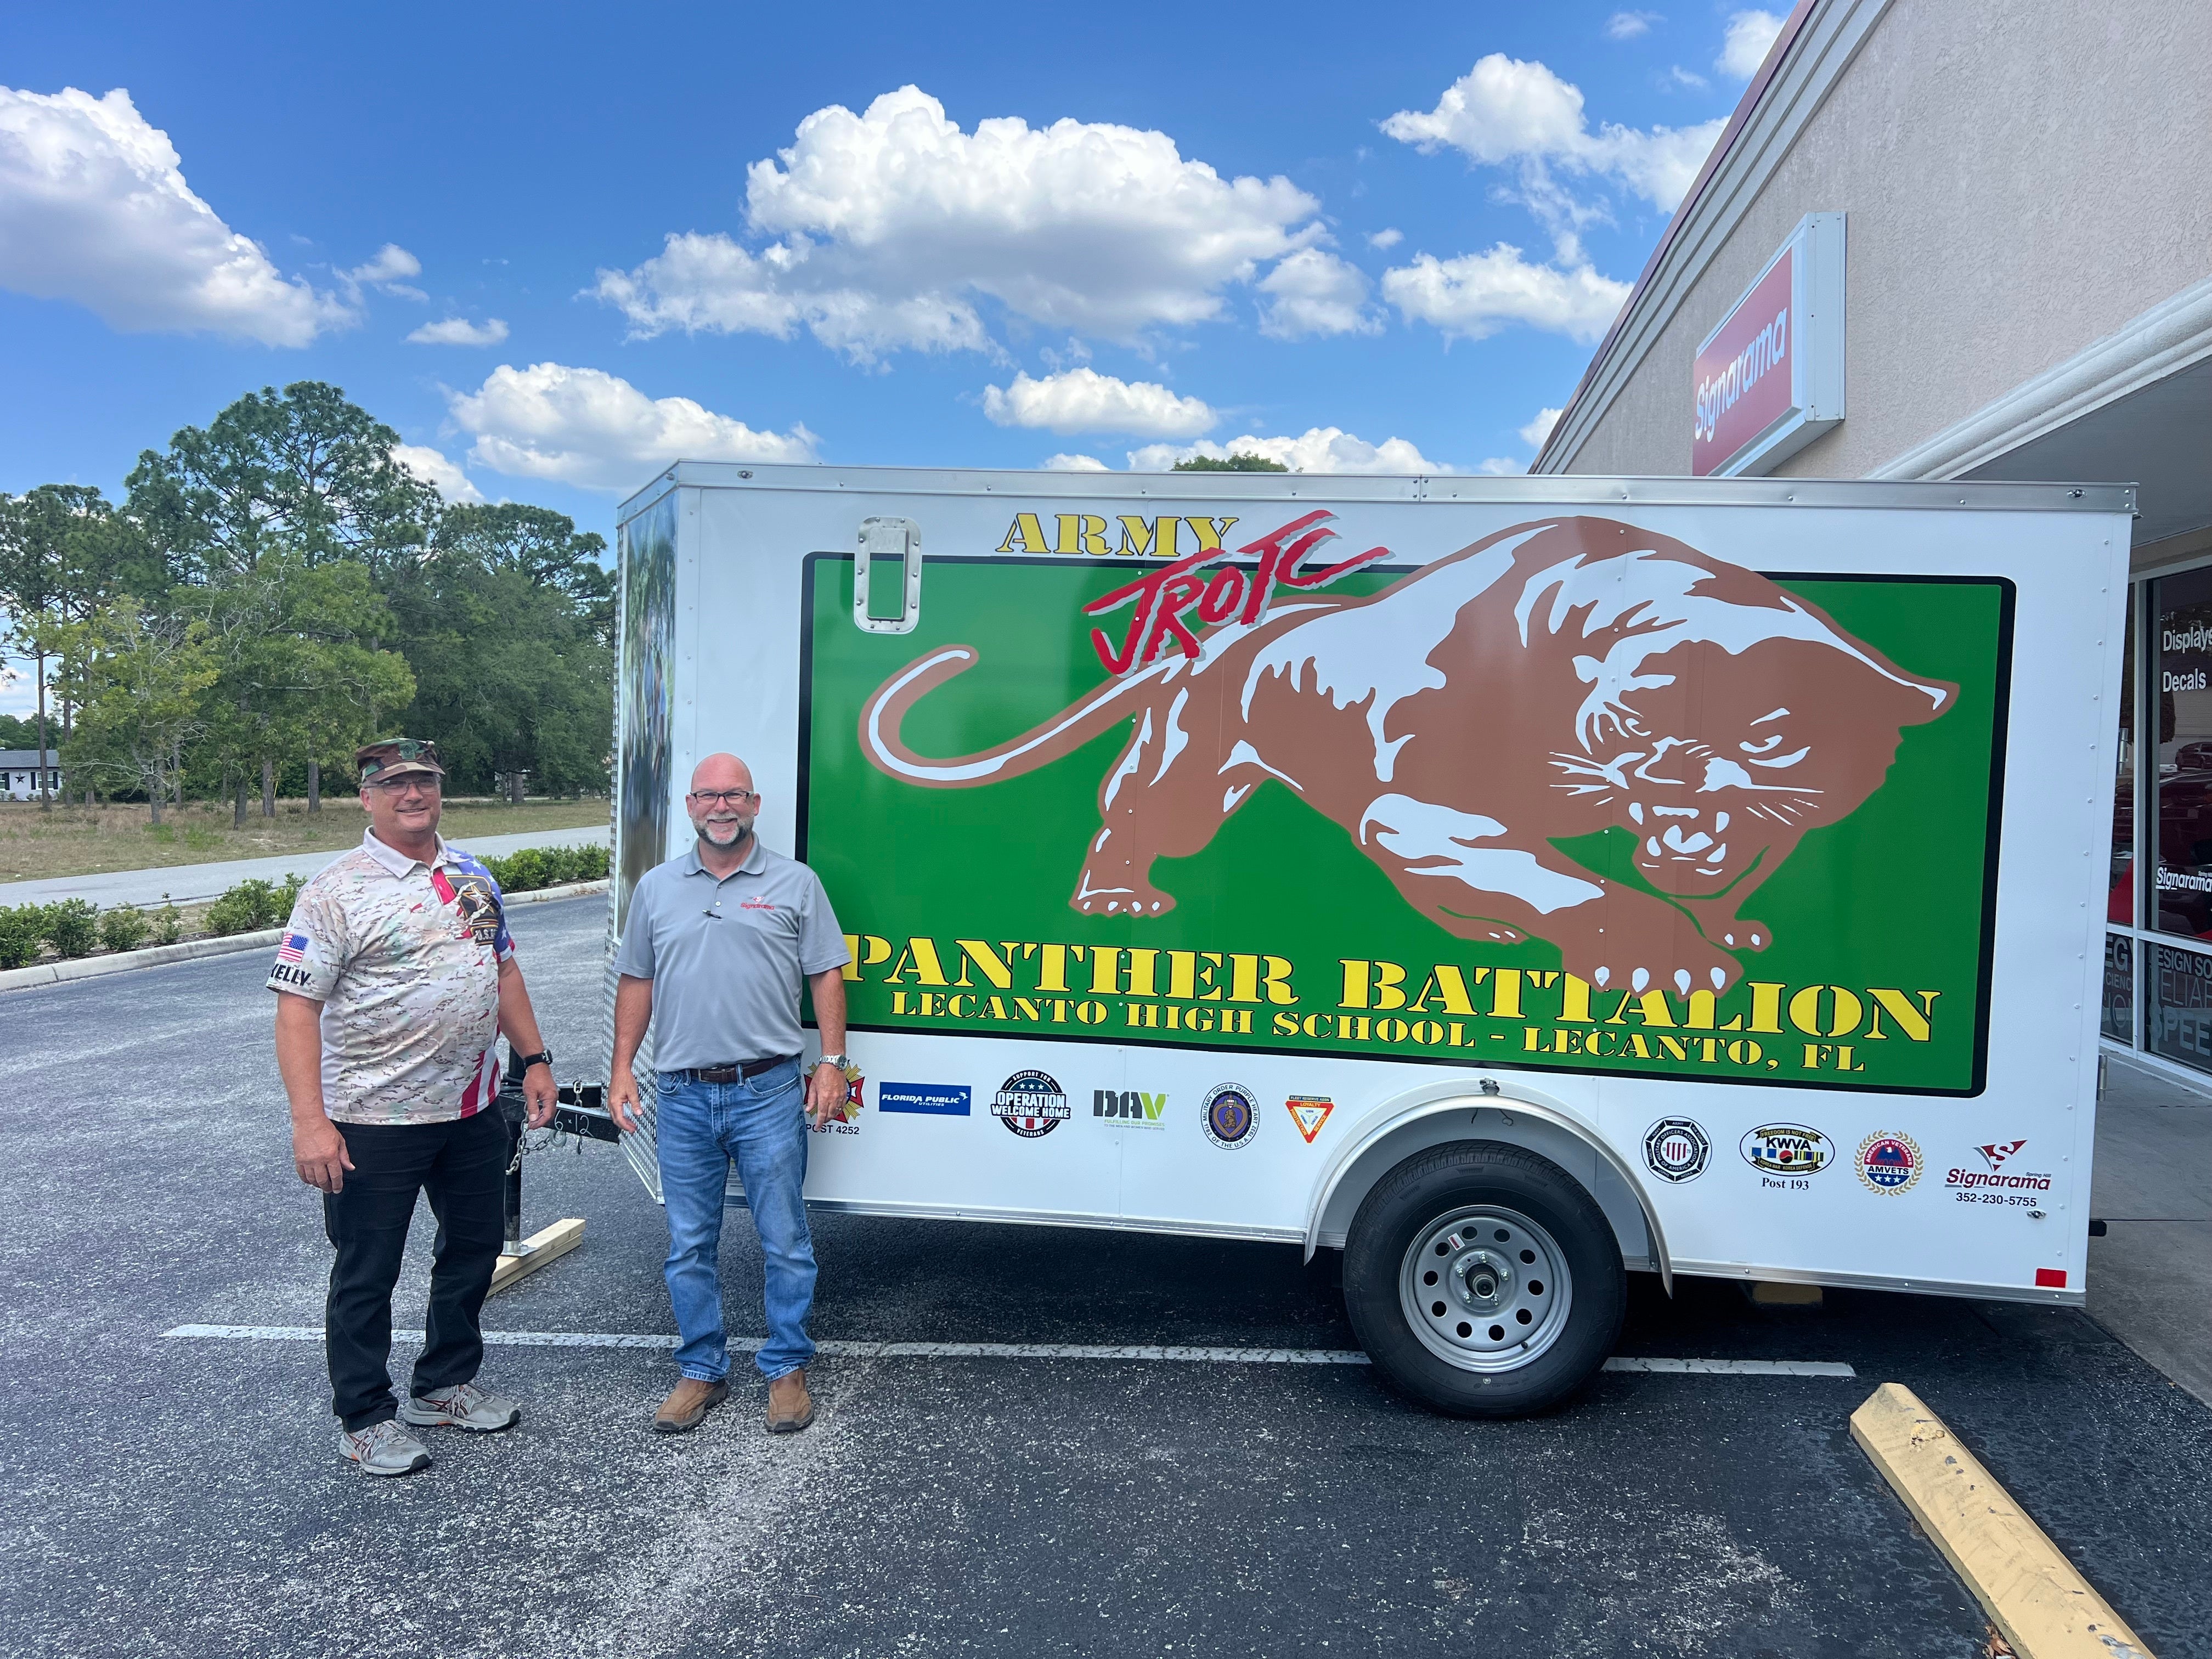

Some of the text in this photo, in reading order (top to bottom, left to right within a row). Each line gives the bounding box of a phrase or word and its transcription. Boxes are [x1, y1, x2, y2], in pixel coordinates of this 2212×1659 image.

[1695, 307, 1787, 442] Signarama
[995, 513, 1239, 556] ARMY
[1082, 510, 1397, 679] JROTC
[2163, 668, 2207, 692] Decals
[2156, 867, 2212, 892] Signarama
[842, 934, 1943, 1042] PANTHER BATTALION
[890, 991, 1109, 1025] LECANTO
[1125, 1002, 1255, 1034] HIGH
[1272, 1012, 1476, 1048] SCHOOL
[1522, 1026, 1780, 1071] LECANTO,
[1801, 1043, 1866, 1073] FL
[1012, 1071, 1051, 1082] SUPPORT FOR
[882, 1094, 923, 1104] FLORIDA
[997, 1092, 1065, 1108] OPERATION
[1093, 1090, 1166, 1120] DAV
[1203, 1095, 1212, 1121] MILITARY
[1213, 1085, 1233, 1096] ORDER
[1235, 1086, 1255, 1103] PURPLE
[992, 1105, 1070, 1118] WELCOME HOME
[1290, 1108, 1308, 1136] PROTECTION
[1313, 1114, 1327, 1132] SERVICE
[836, 1126, 860, 1135] 4252
[1017, 1128, 1045, 1137] VETERANS
[1248, 1125, 1257, 1138] 1932
[1652, 1127, 1661, 1137] NAVY
[1661, 1129, 1684, 1139] OFFICERS
[1761, 1129, 1785, 1137] FREEDOM
[1802, 1133, 1815, 1141] FREE
[1684, 1132, 1698, 1164] ASSOCIATION
[1766, 1137, 1812, 1151] KWVA
[1866, 1141, 1912, 1166] AMERICAN VETERANS
[1668, 1163, 1692, 1171] AMERICA
[1867, 1165, 1909, 1175] AMVETS
[1761, 1177, 1809, 1190] Post 193
[1946, 1168, 2051, 1190] Signarama
[1956, 1192, 2037, 1207] 352-230-5755
